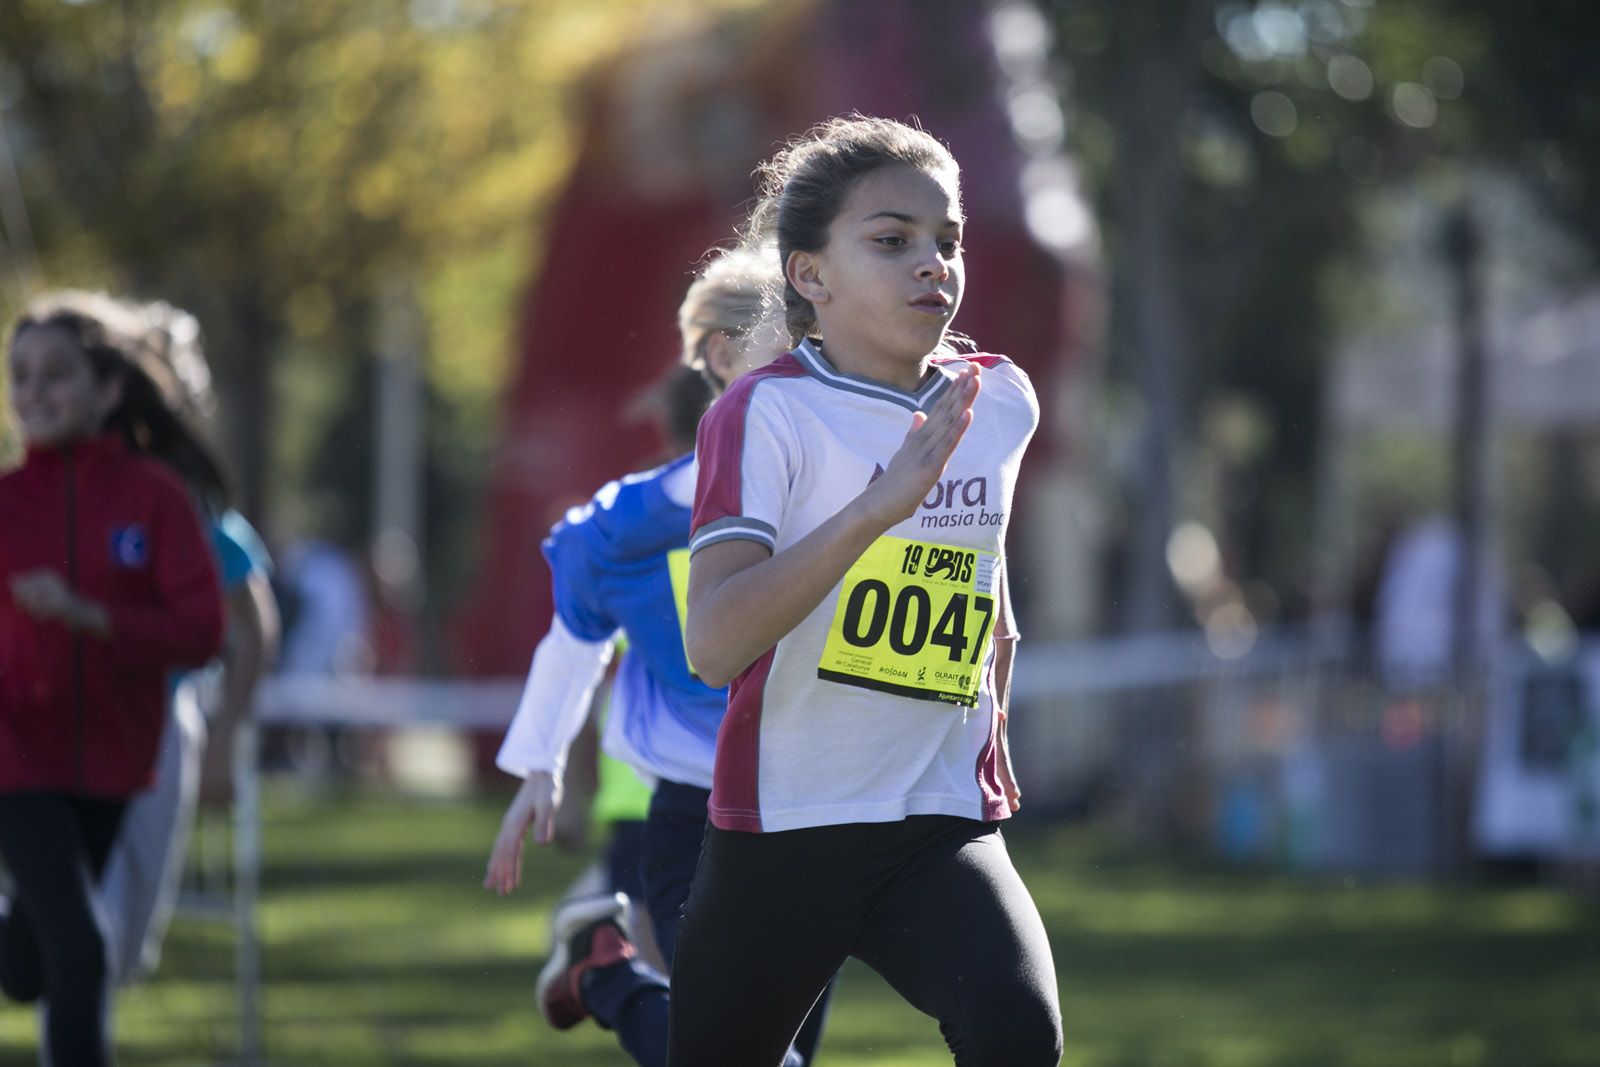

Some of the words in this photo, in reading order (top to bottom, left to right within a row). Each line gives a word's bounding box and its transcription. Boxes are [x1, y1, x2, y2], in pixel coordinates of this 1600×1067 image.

[921, 510, 974, 528] masia
[901, 544, 924, 575] 19
[842, 578, 994, 665] 0047
[934, 671, 959, 681] OLRAIT
